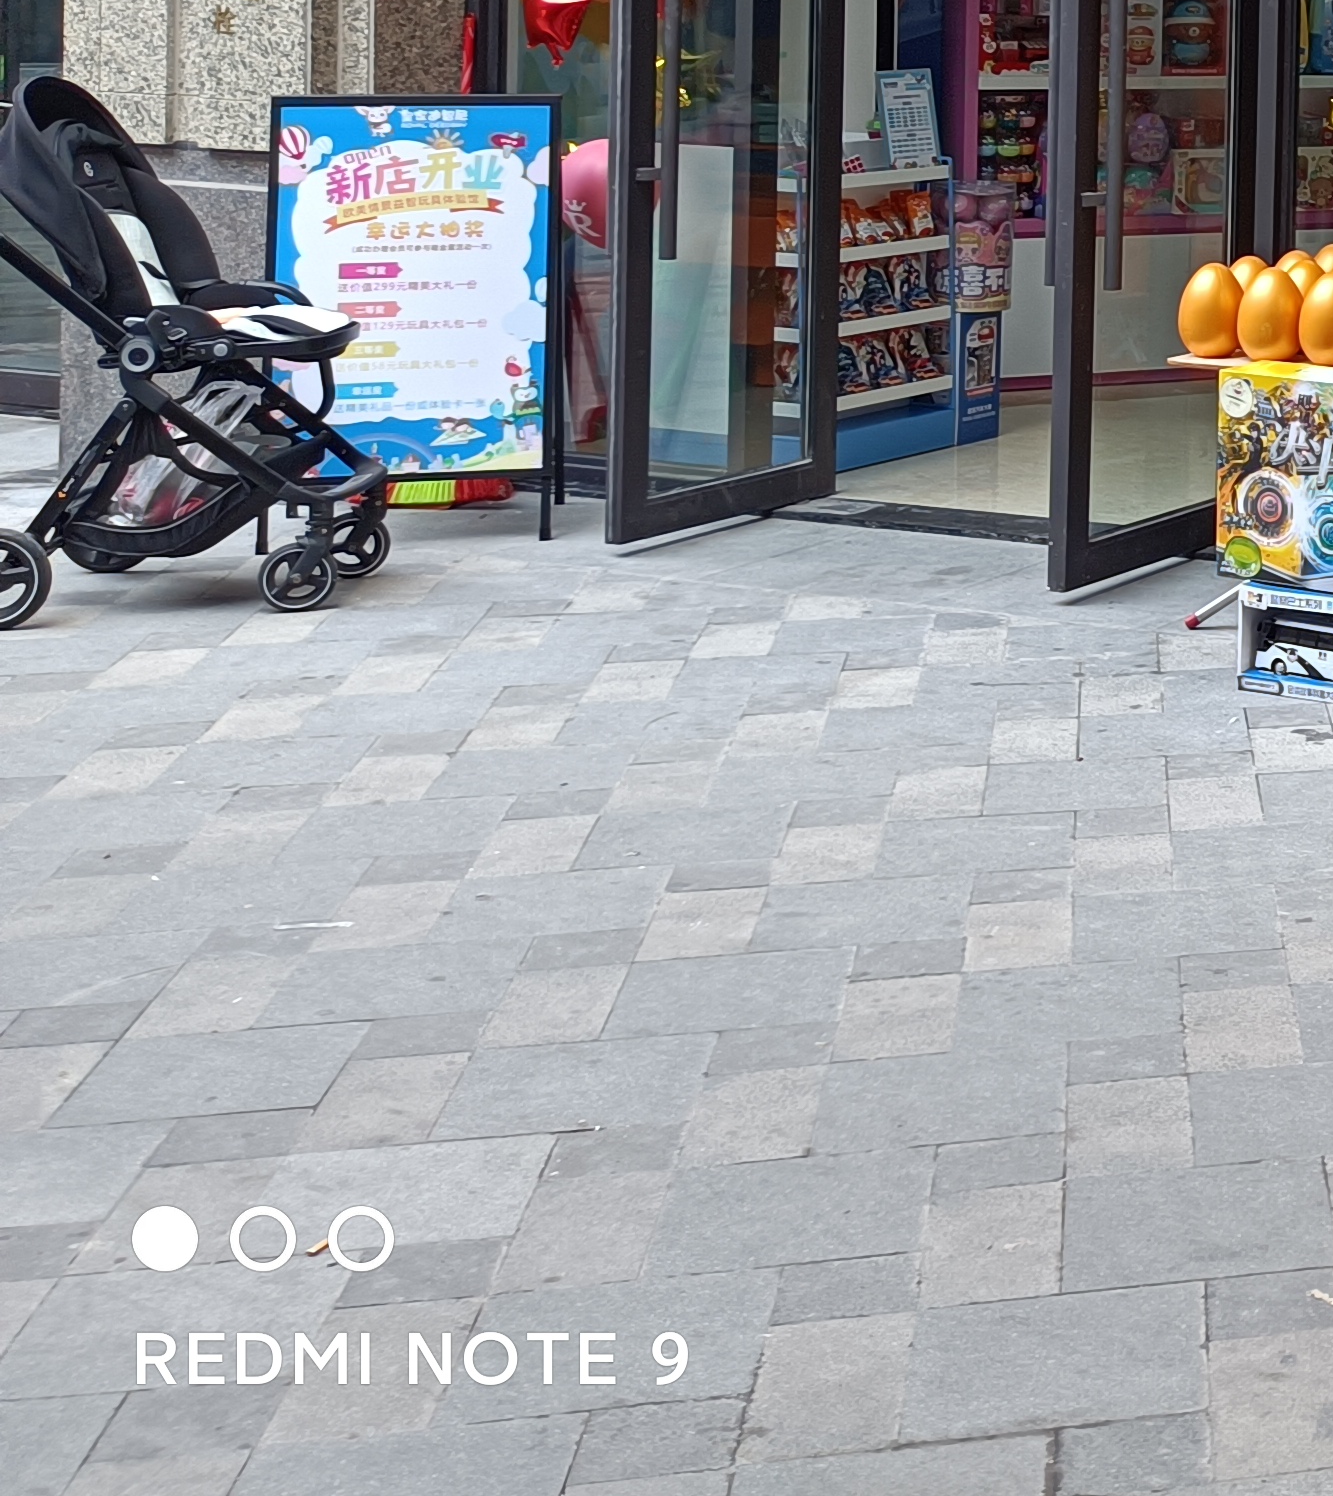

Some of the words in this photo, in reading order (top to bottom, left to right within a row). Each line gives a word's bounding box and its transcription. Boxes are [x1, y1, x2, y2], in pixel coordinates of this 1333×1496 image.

[344, 144, 392, 166] open
[326, 149, 504, 204] 新店开业
[366, 220, 485, 241] 幸运大抽奖
